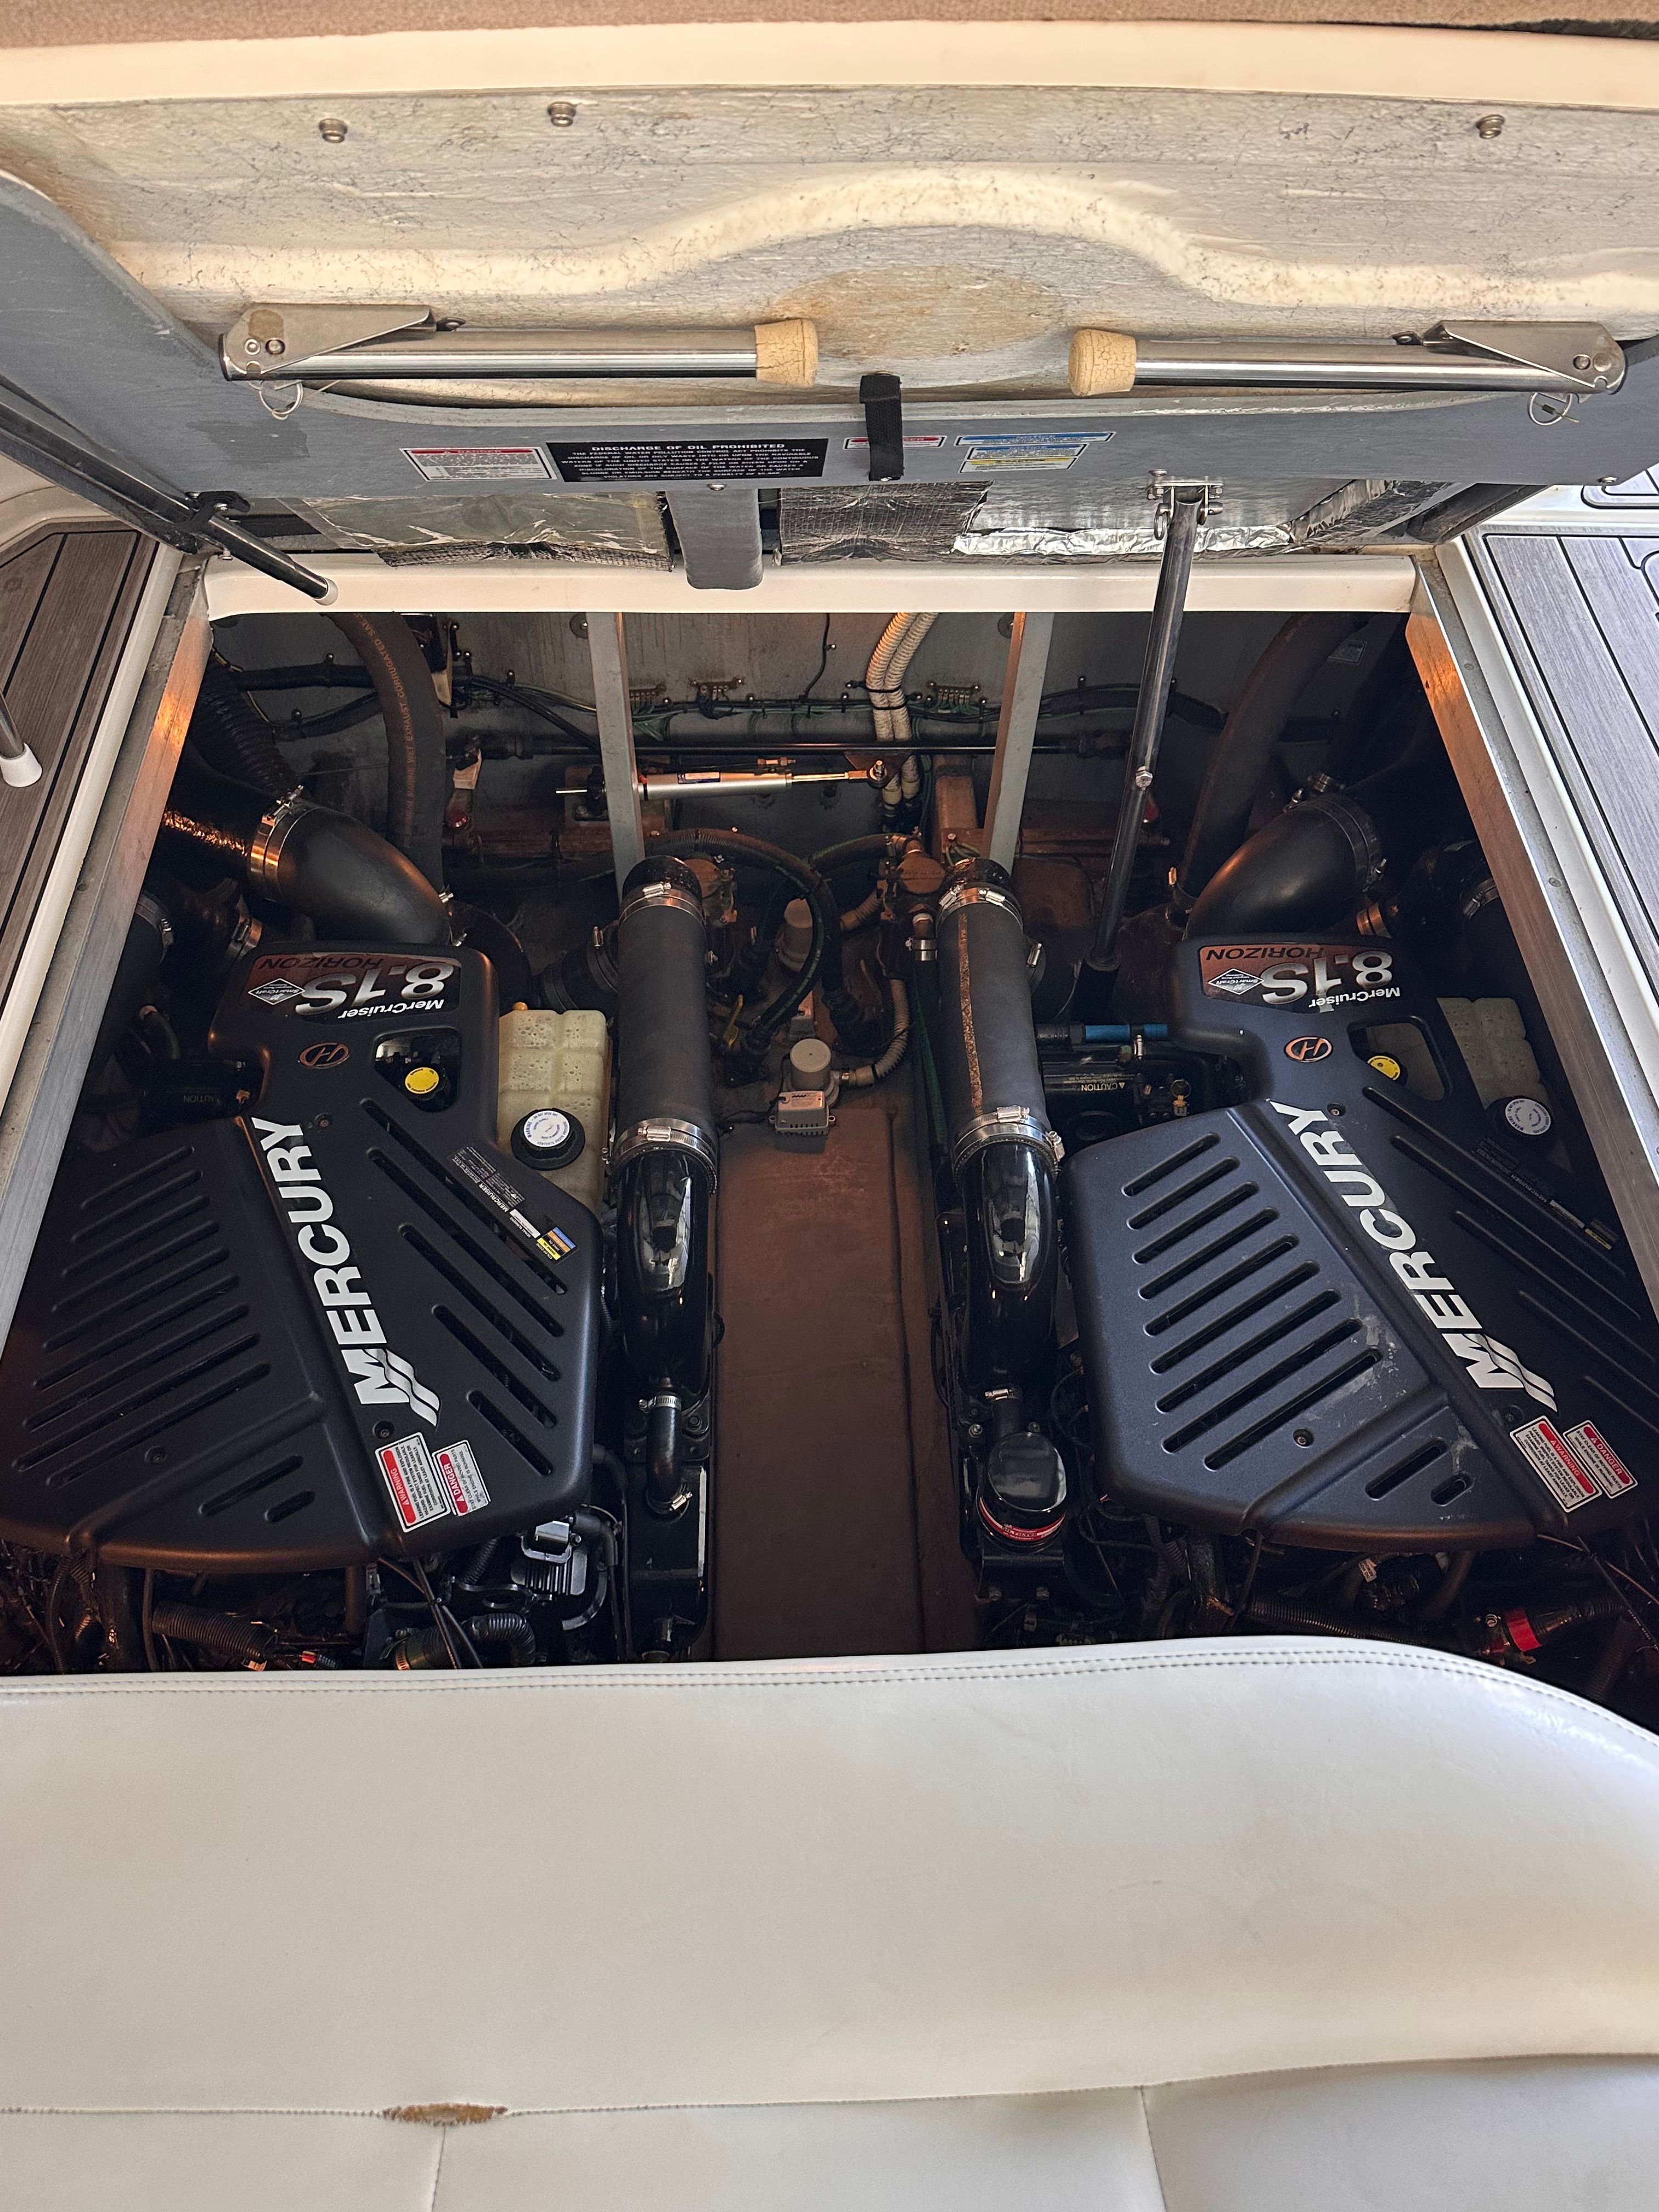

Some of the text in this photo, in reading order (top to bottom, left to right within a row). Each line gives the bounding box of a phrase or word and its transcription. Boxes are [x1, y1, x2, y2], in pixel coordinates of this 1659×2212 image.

[374, 639, 405, 697] CORRUGATED
[400, 702, 413, 741] EXHAUST
[258, 958, 384, 969] HORIZON
[1205, 947, 1324, 960] HORIZON
[295, 962, 454, 1015] 8.1S
[1260, 950, 1393, 1005] 8.1S
[337, 1000, 444, 1019] MerCruiser
[1307, 987, 1401, 1008] MerCruiser
[1081, 1082, 1118, 1091] CAUTION
[1268, 1099, 1558, 1412] MERCURY
[251, 1116, 440, 1427] MERCURY
[394, 1446, 405, 1468] EXPLOSION
[408, 1451, 416, 1464] LEAKS
[450, 1449, 459, 1463] PARTS
[1523, 1439, 1542, 1461] CORROSION
[1543, 1465, 1554, 1479] LEAST
[1531, 1427, 1545, 1443] LEAKING
[1542, 1442, 1553, 1453] FUEL
[1555, 1459, 1564, 1469] FIRE
[1561, 1468, 1571, 1477] AND
[1567, 1476, 1586, 1498] EXPLOSION
[1539, 1446, 1553, 1462] INSPECT
[1550, 1461, 1564, 1477] SYSTEM
[1554, 1444, 1581, 1477] WARNING
[1573, 1436, 1585, 1449] WHILE
[1583, 1449, 1596, 1464] ENGINE
[1576, 1430, 1586, 1441] STAY
[1583, 1440, 1596, 1454] CLEAR
[1598, 1459, 1613, 1476] MOVING
[1610, 1475, 1623, 1489] PARTS
[1595, 1443, 1624, 1475] DANGER
[408, 1468, 417, 1483] SYSTEM
[420, 1465, 428, 1479] LEAST
[1525, 1434, 1539, 1451] EXAMINE
[1537, 1450, 1547, 1460] FUEL
[1544, 1459, 1556, 1472] TANKS
[1553, 1471, 1561, 1481] FOR
[1559, 1480, 1571, 1493] LEAKS
[390, 1467, 408, 1502] WARNING
[414, 1482, 424, 1499] INSPECT
[416, 1471, 424, 1485] TANKS
[442, 1463, 462, 1496] DANGER
[424, 1494, 434, 1511] EXAMINE
[426, 1483, 438, 1506] CORROSION
[464, 1485, 473, 1499] CLEAR
[415, 1502, 425, 1519] LEAKING
